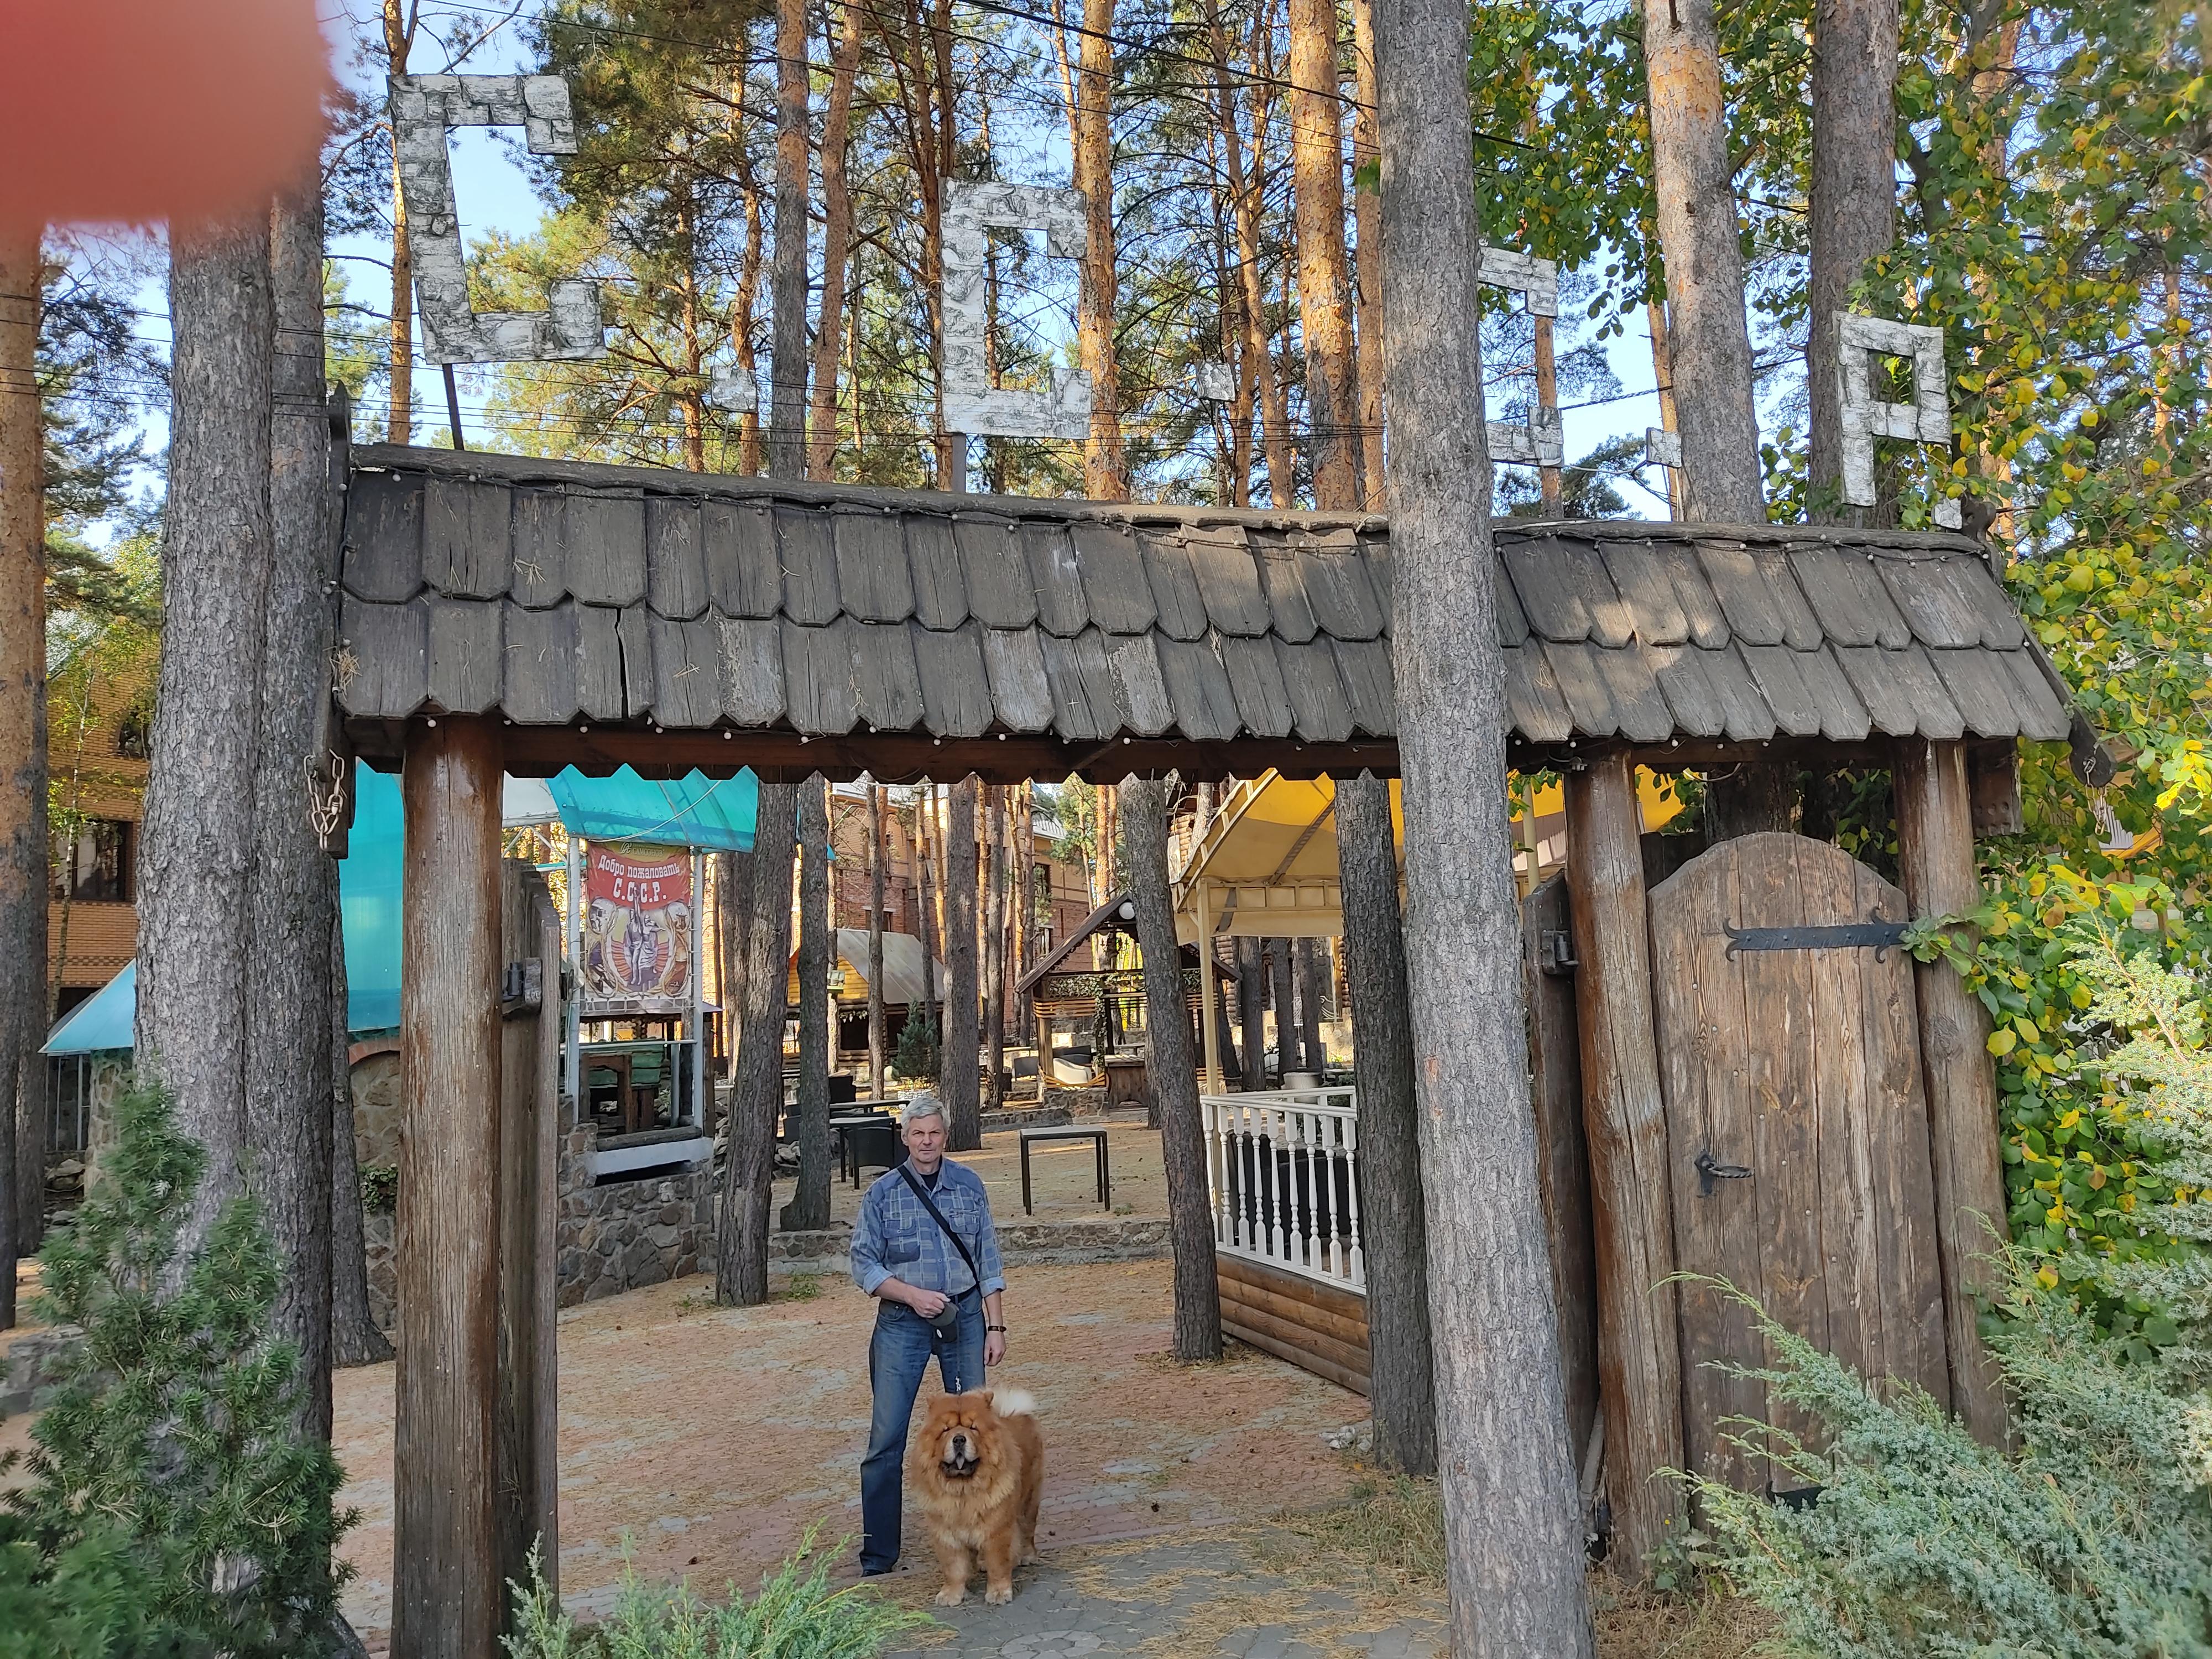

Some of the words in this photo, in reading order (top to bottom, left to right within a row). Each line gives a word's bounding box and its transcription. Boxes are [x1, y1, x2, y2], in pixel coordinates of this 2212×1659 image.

[598, 854, 624, 877] Добро
[627, 863, 680, 879] пожаловать
[613, 877, 667, 903] С.СС.Р.
